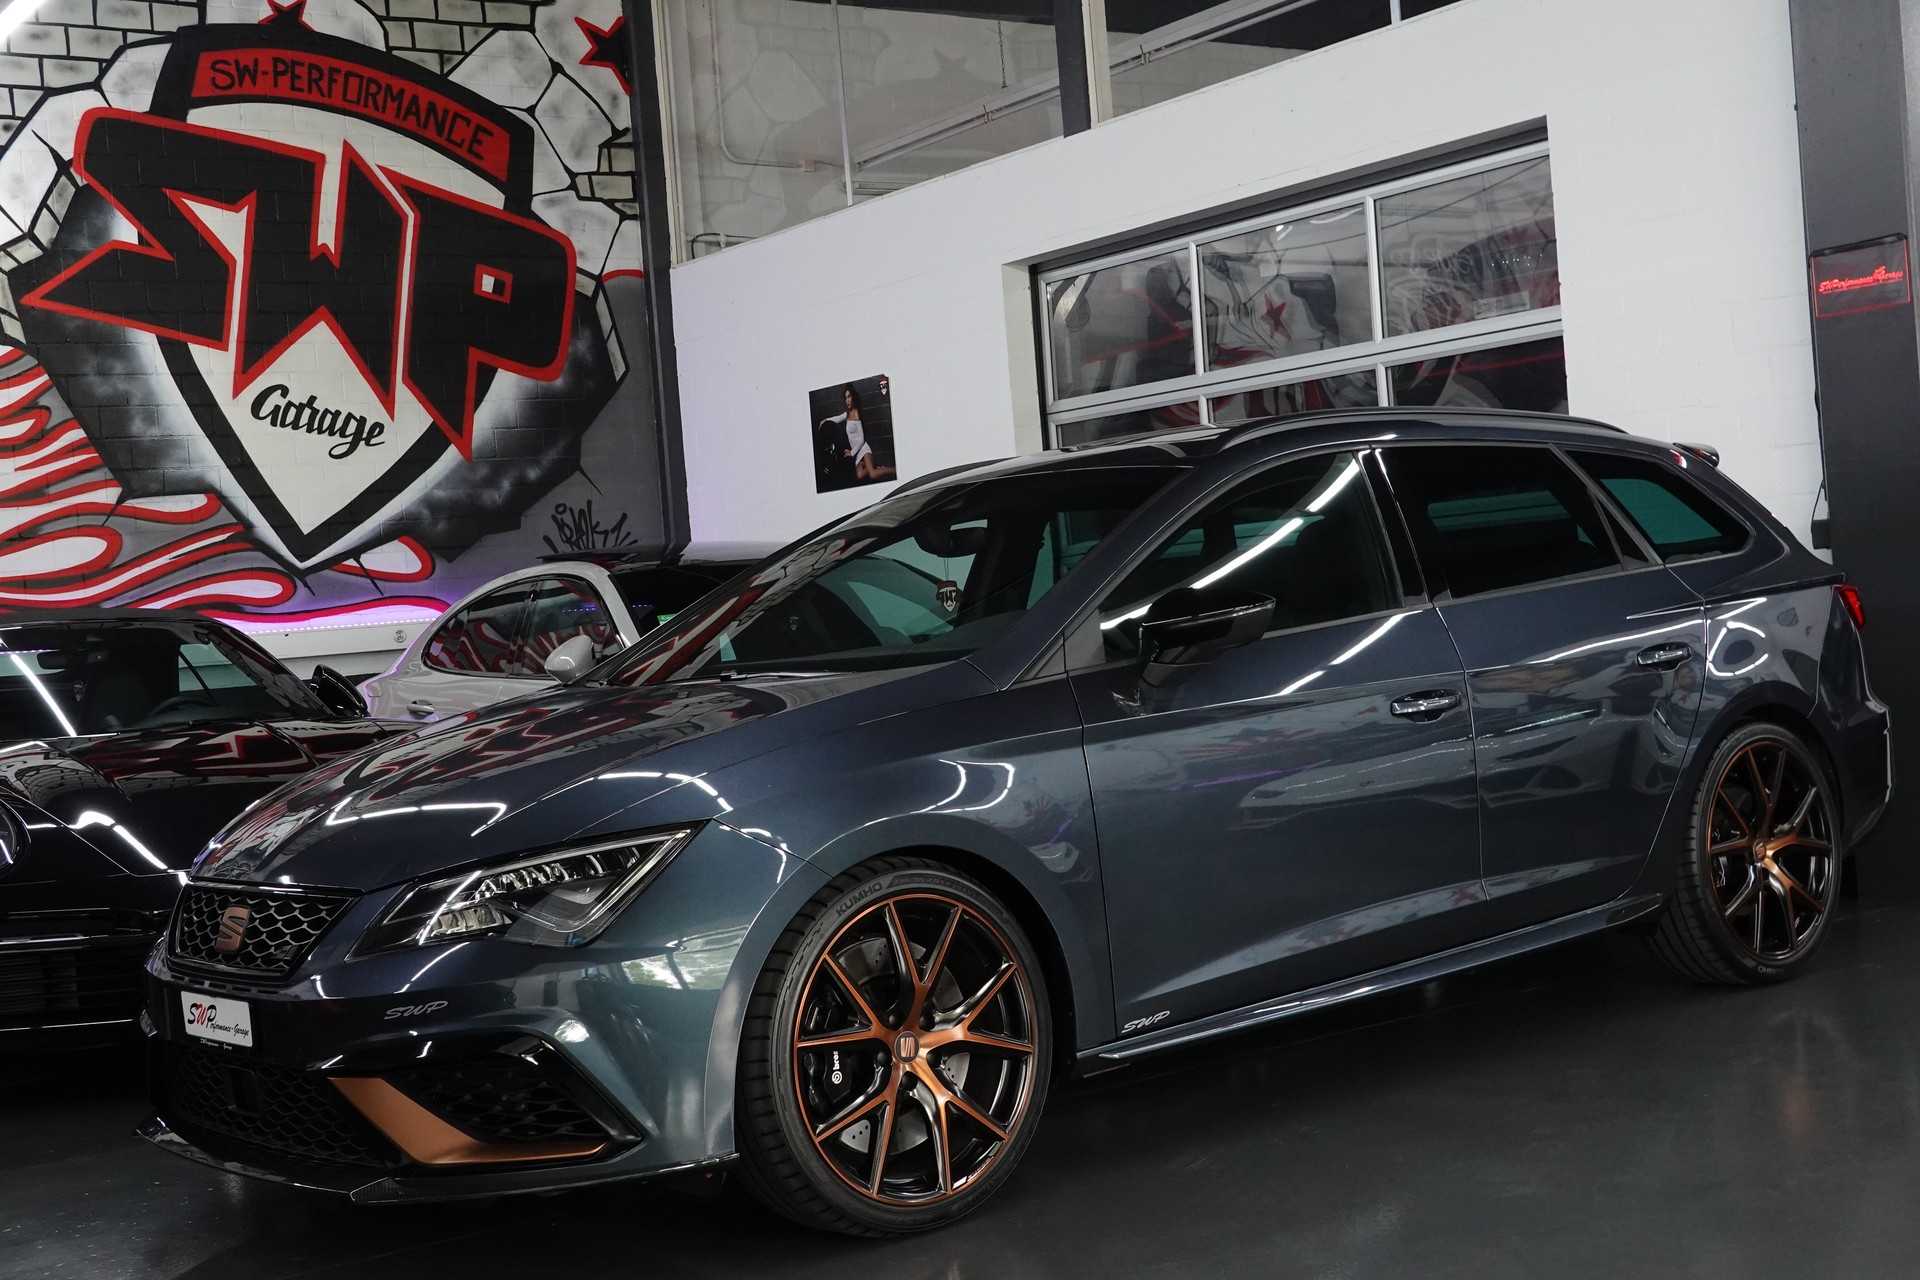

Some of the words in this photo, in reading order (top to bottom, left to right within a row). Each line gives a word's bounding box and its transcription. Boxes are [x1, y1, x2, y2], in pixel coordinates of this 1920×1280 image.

[210, 57, 494, 160] SW-PERFORMANCE
[20, 107, 577, 462] SWP
[251, 384, 385, 459] Garage
[836, 882, 883, 917] KUMHO
[384, 1001, 448, 1019] SWP
[1121, 1010, 1170, 1033] SWP
